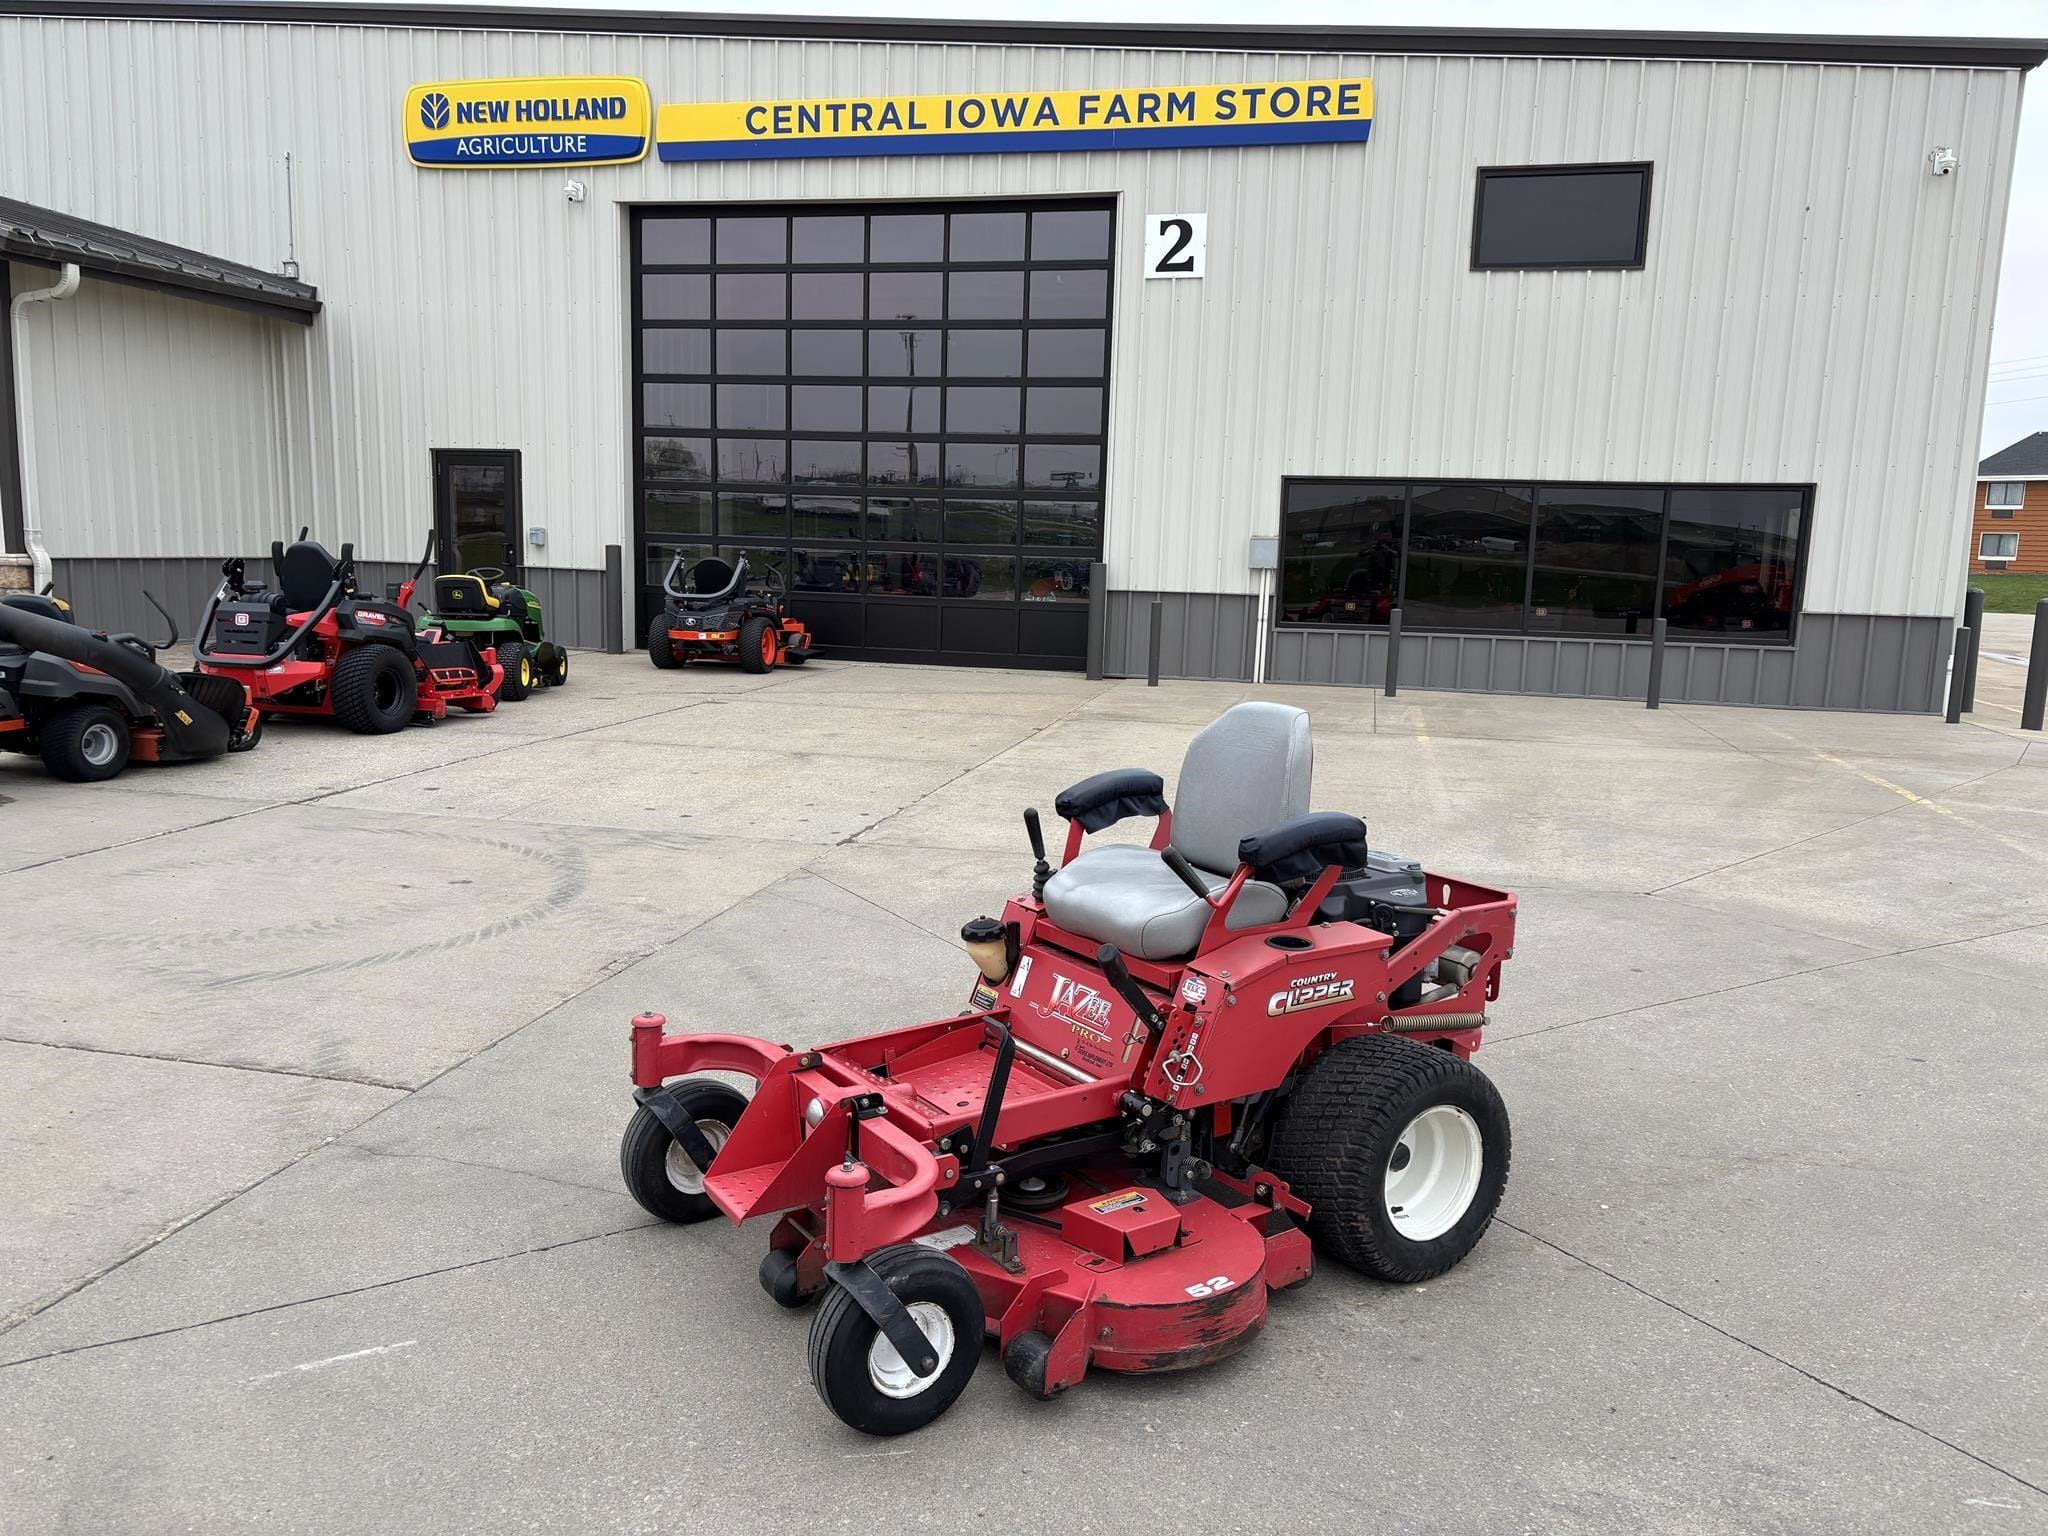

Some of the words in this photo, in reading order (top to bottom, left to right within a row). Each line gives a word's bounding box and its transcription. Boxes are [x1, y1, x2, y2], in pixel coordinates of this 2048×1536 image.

[456, 101, 509, 124] NEW
[516, 96, 627, 122] HOLLAND
[745, 100, 927, 135] CENTRAL
[945, 96, 1060, 129] IOWA
[1079, 91, 1197, 125] FARM
[1214, 83, 1361, 120] STORE
[456, 136, 587, 156] AGRICULTURE
[1155, 219, 1194, 272] 2
[1290, 971, 1338, 988] COUNTRY
[1268, 979, 1355, 1016] CLIPPER
[1071, 1023, 1101, 1043] PRO
[1184, 1275, 1236, 1298] 52
